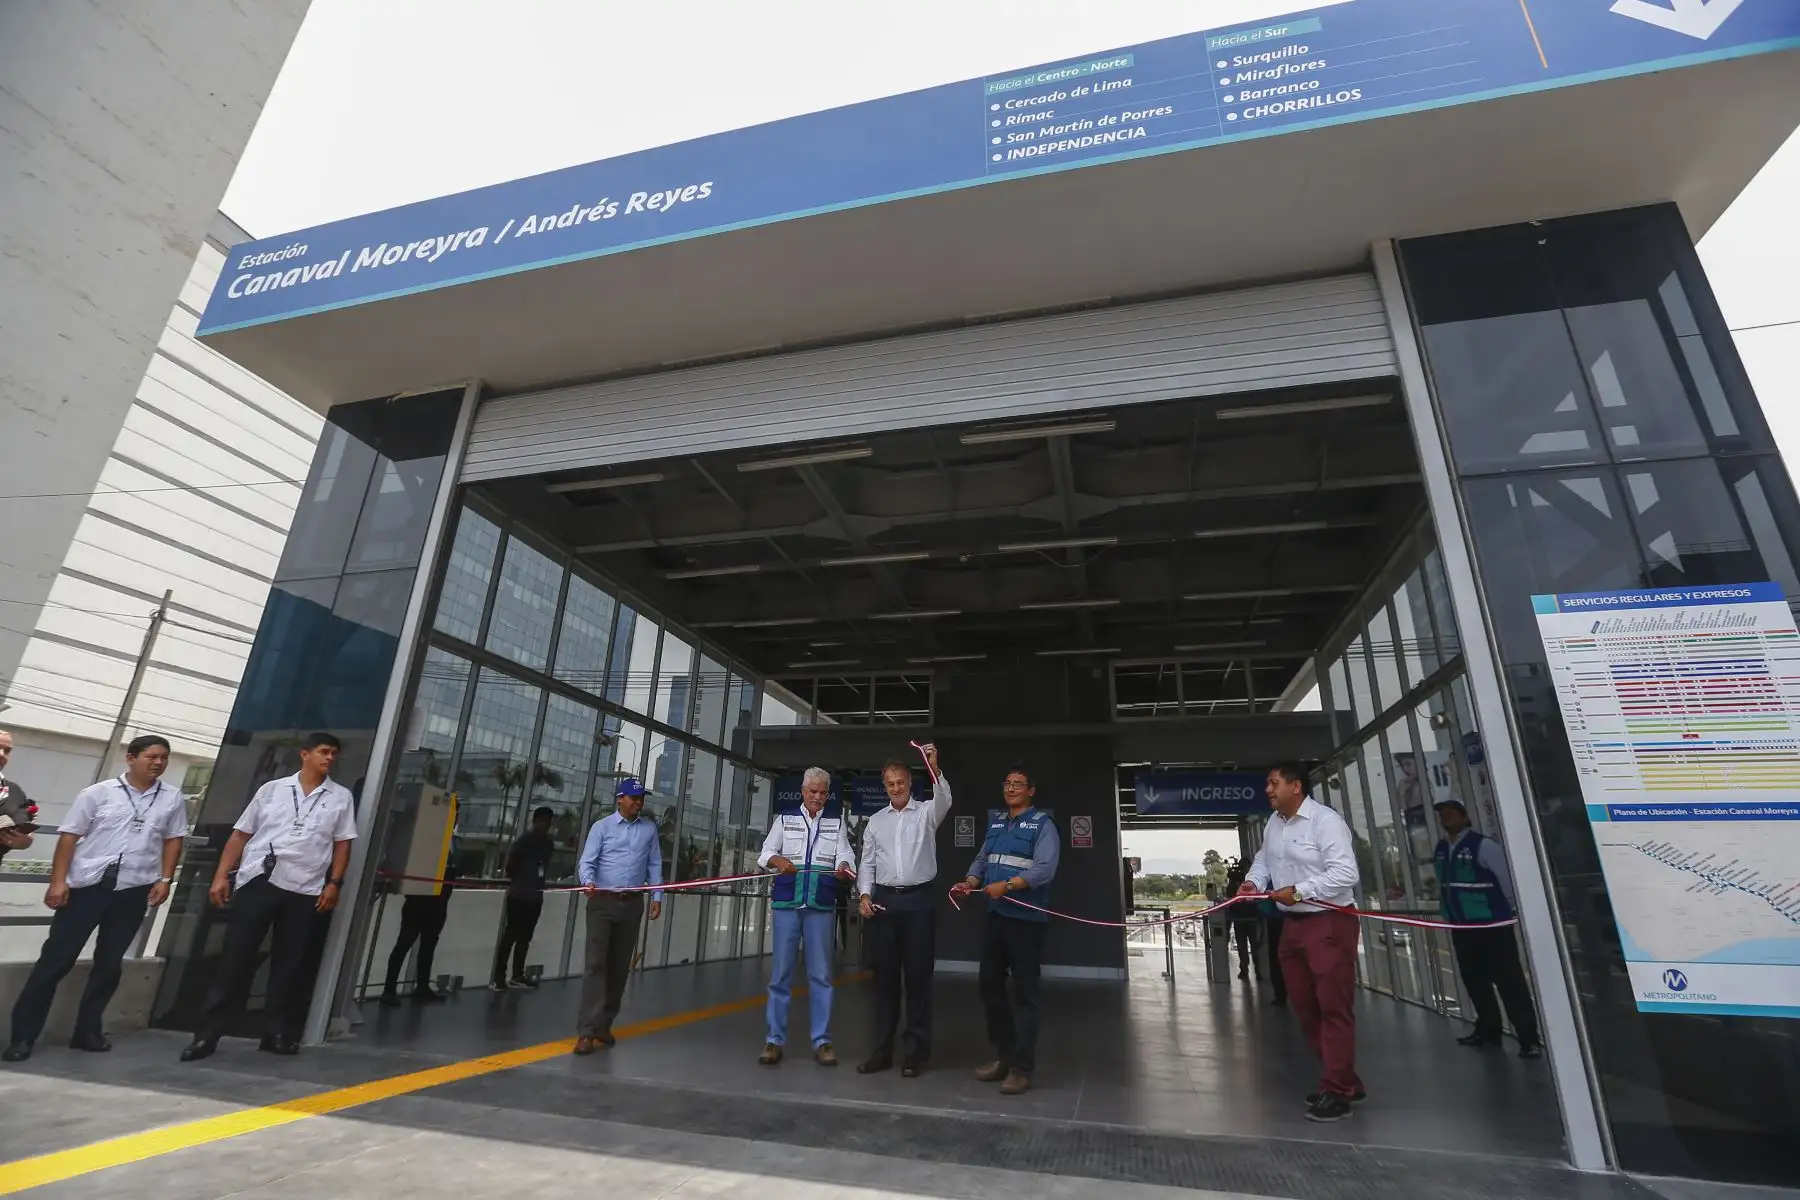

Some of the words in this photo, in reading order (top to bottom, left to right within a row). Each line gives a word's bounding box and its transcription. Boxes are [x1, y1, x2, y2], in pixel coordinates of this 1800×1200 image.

[1210, 33, 1247, 48] Hacia
[1251, 30, 1262, 41] el
[1264, 26, 1288, 38] Sur
[1232, 43, 1309, 67] Surquillo
[989, 80, 1022, 93] Hacia
[1024, 75, 1035, 84] el
[1037, 67, 1079, 82] Centro
[1090, 57, 1128, 72] Norte
[1235, 58, 1326, 84] Miraflores
[1004, 89, 1067, 110] Cercado
[1071, 84, 1090, 98] de
[1093, 77, 1132, 93] Lima
[1239, 78, 1320, 102] Barranco
[1242, 88, 1362, 120] CHORRILLOS
[1005, 108, 1055, 126] Rímac
[1006, 130, 1035, 144] San
[1039, 118, 1093, 138] Martín
[1097, 113, 1117, 127] de
[1121, 104, 1173, 123] Porres
[1007, 126, 1147, 161] INDEPENDENCIA
[227, 246, 351, 299] Canaval
[351, 222, 489, 273] Moreyra
[494, 219, 515, 243] /
[515, 198, 618, 237] Andrés
[624, 180, 713, 215] Reyes
[238, 242, 308, 270] Estación
[1563, 596, 1619, 607] SERVICIOS
[1620, 592, 1682, 604] REGULARES
[1683, 592, 1691, 600] Y
[1693, 589, 1752, 600] EXPRESOS
[777, 791, 802, 800] SOLO
[1181, 786, 1256, 801] INGRESO
[1613, 808, 1636, 816] Plano
[1637, 808, 1648, 816] de
[1649, 807, 1688, 816] Ubicación
[1693, 807, 1728, 816] Estación
[1729, 807, 1763, 815] Canaval
[1764, 807, 1799, 816] Moreyra
[1643, 991, 1718, 1001] METROPOLITANO
